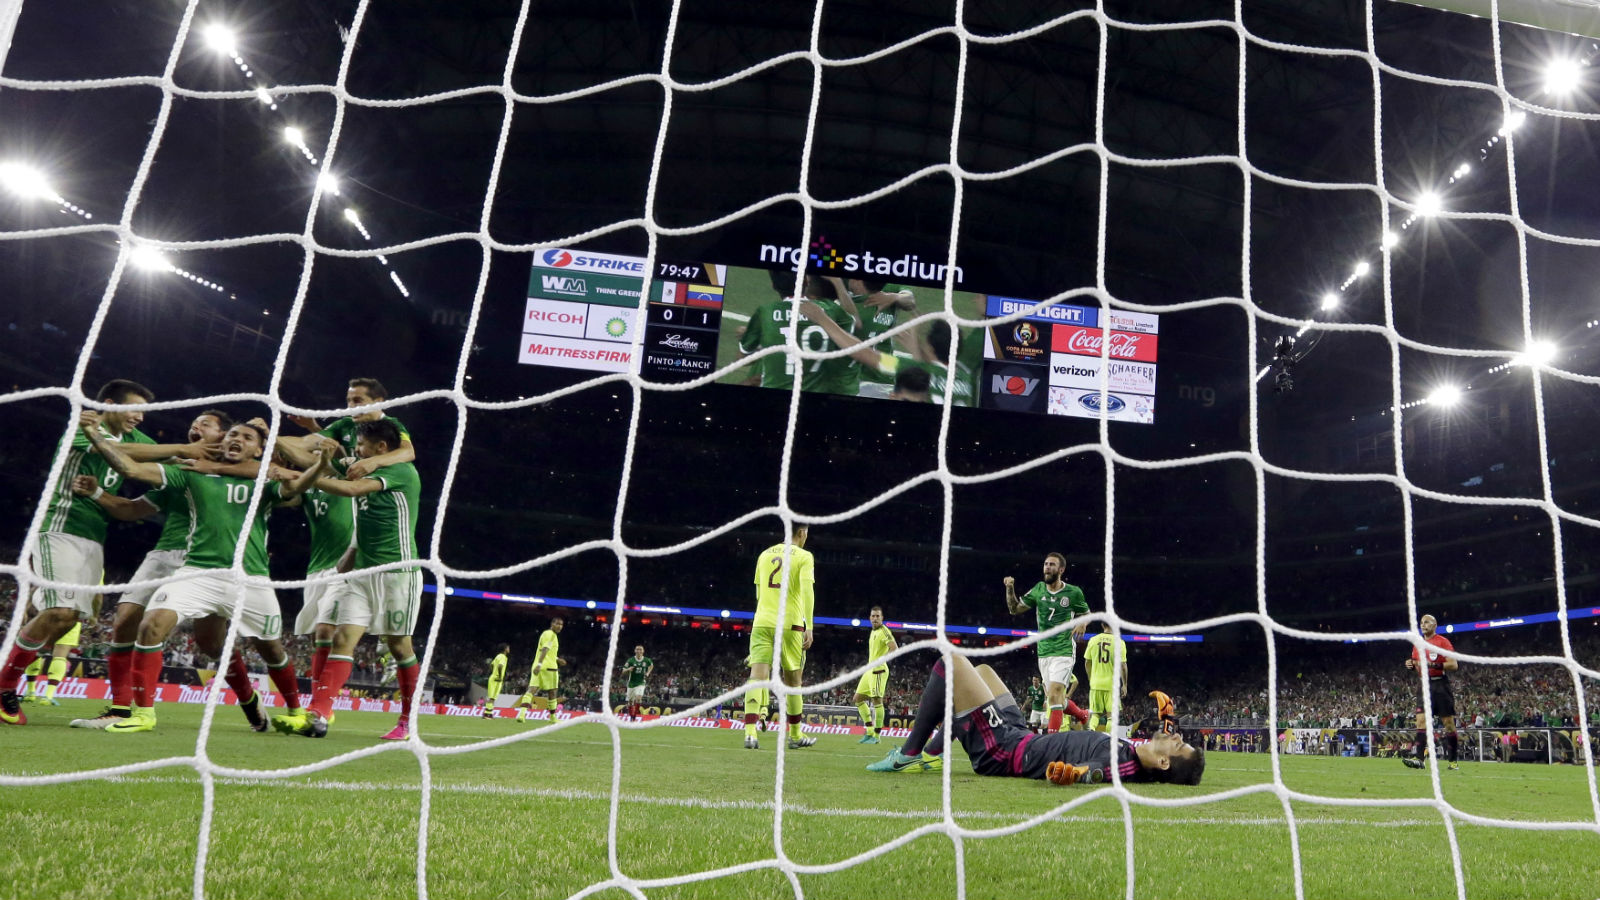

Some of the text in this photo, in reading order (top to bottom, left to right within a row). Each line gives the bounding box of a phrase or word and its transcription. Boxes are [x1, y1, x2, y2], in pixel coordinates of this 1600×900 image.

[574, 256, 645, 272] STRIKE
[660, 264, 700, 279] 79:47
[760, 244, 963, 283] nrg stadium
[542, 275, 587, 293] WM
[595, 287, 617, 296] THINK
[618, 288, 641, 298] GREEN
[528, 310, 583, 325] RICOH
[663, 309, 673, 321] 0
[702, 313, 708, 324] 1
[1038, 306, 1082, 321] LIGHT
[647, 355, 711, 370] PINTO RANCH
[1053, 365, 1095, 377] verizon
[1180, 384, 1216, 408] nrg
[104, 466, 119, 488] 8
[226, 483, 249, 504] 10
[768, 557, 783, 588] 2
[386, 610, 405, 632] 19
[1048, 607, 1056, 621] 7
[262, 615, 281, 635] 10
[1097, 642, 1111, 664] 15
